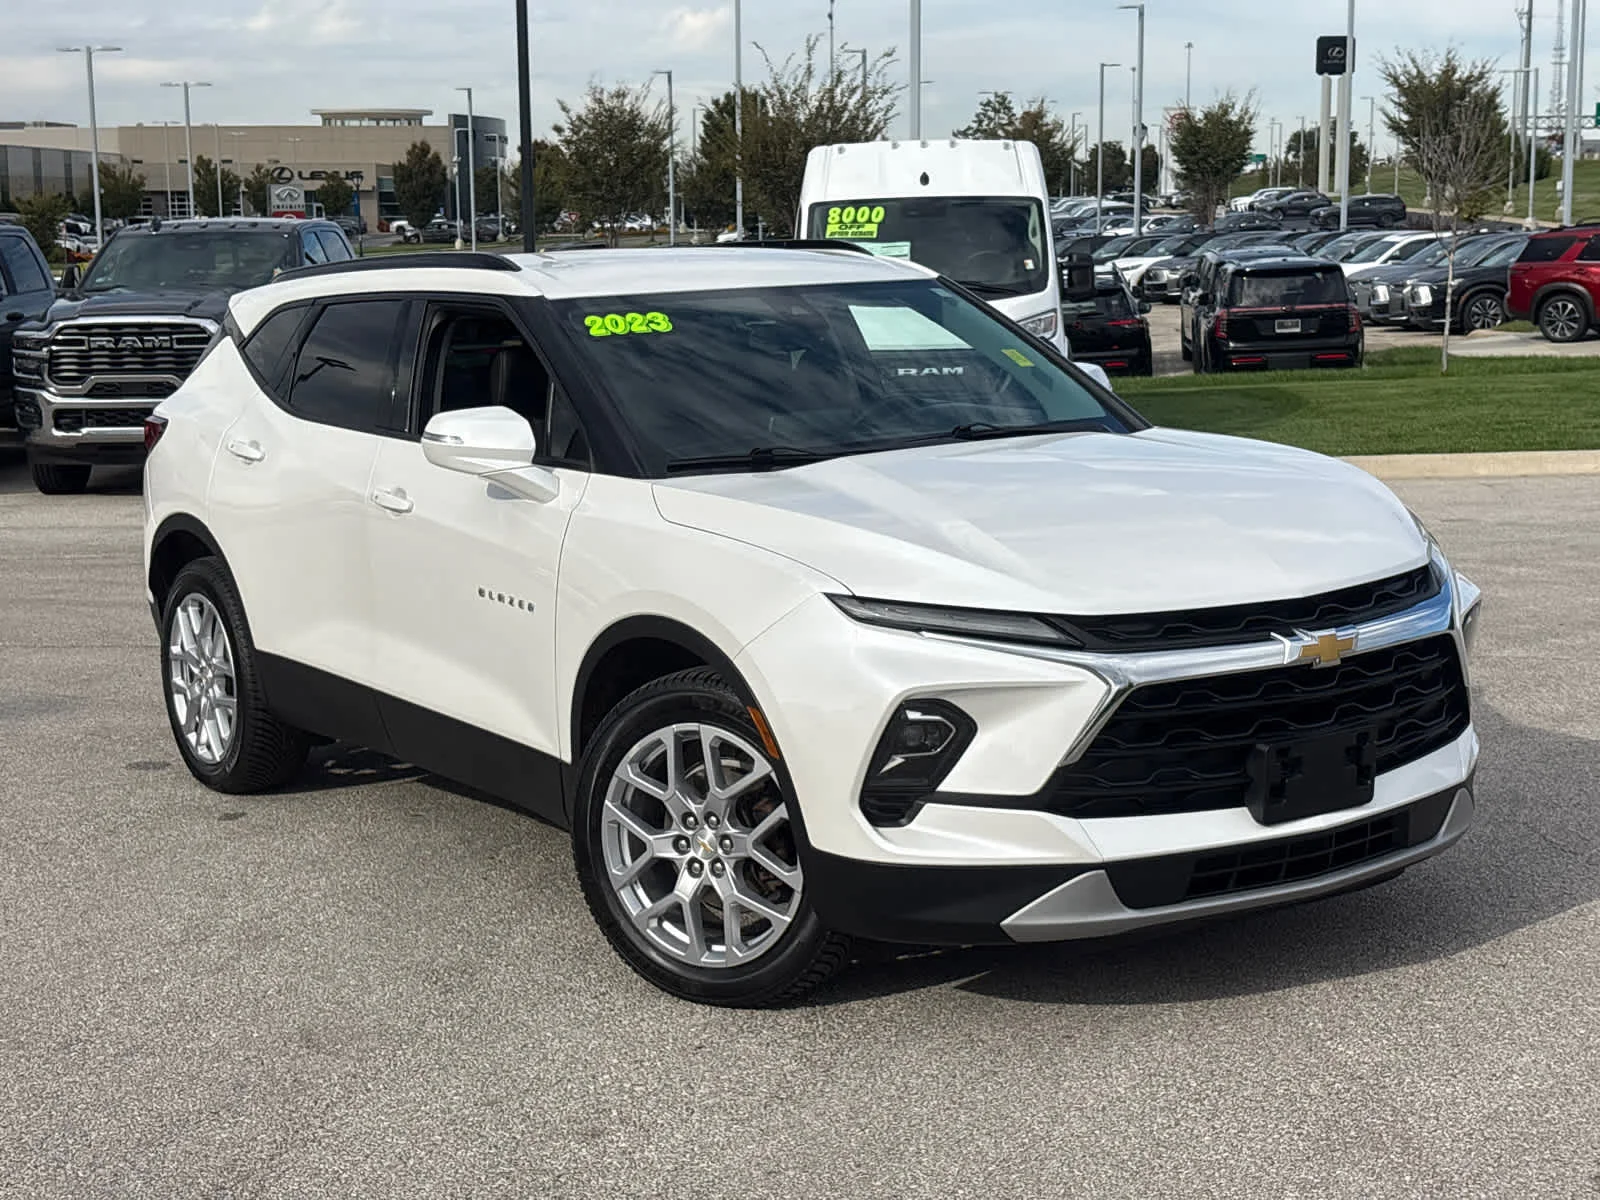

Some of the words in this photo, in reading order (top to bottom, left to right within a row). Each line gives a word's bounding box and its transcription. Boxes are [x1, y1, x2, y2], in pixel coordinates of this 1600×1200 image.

[827, 206, 885, 224] 8000
[584, 311, 673, 336] 2023
[89, 336, 171, 348] RAM
[897, 366, 964, 376] RAM
[478, 587, 535, 612] BLAZER
